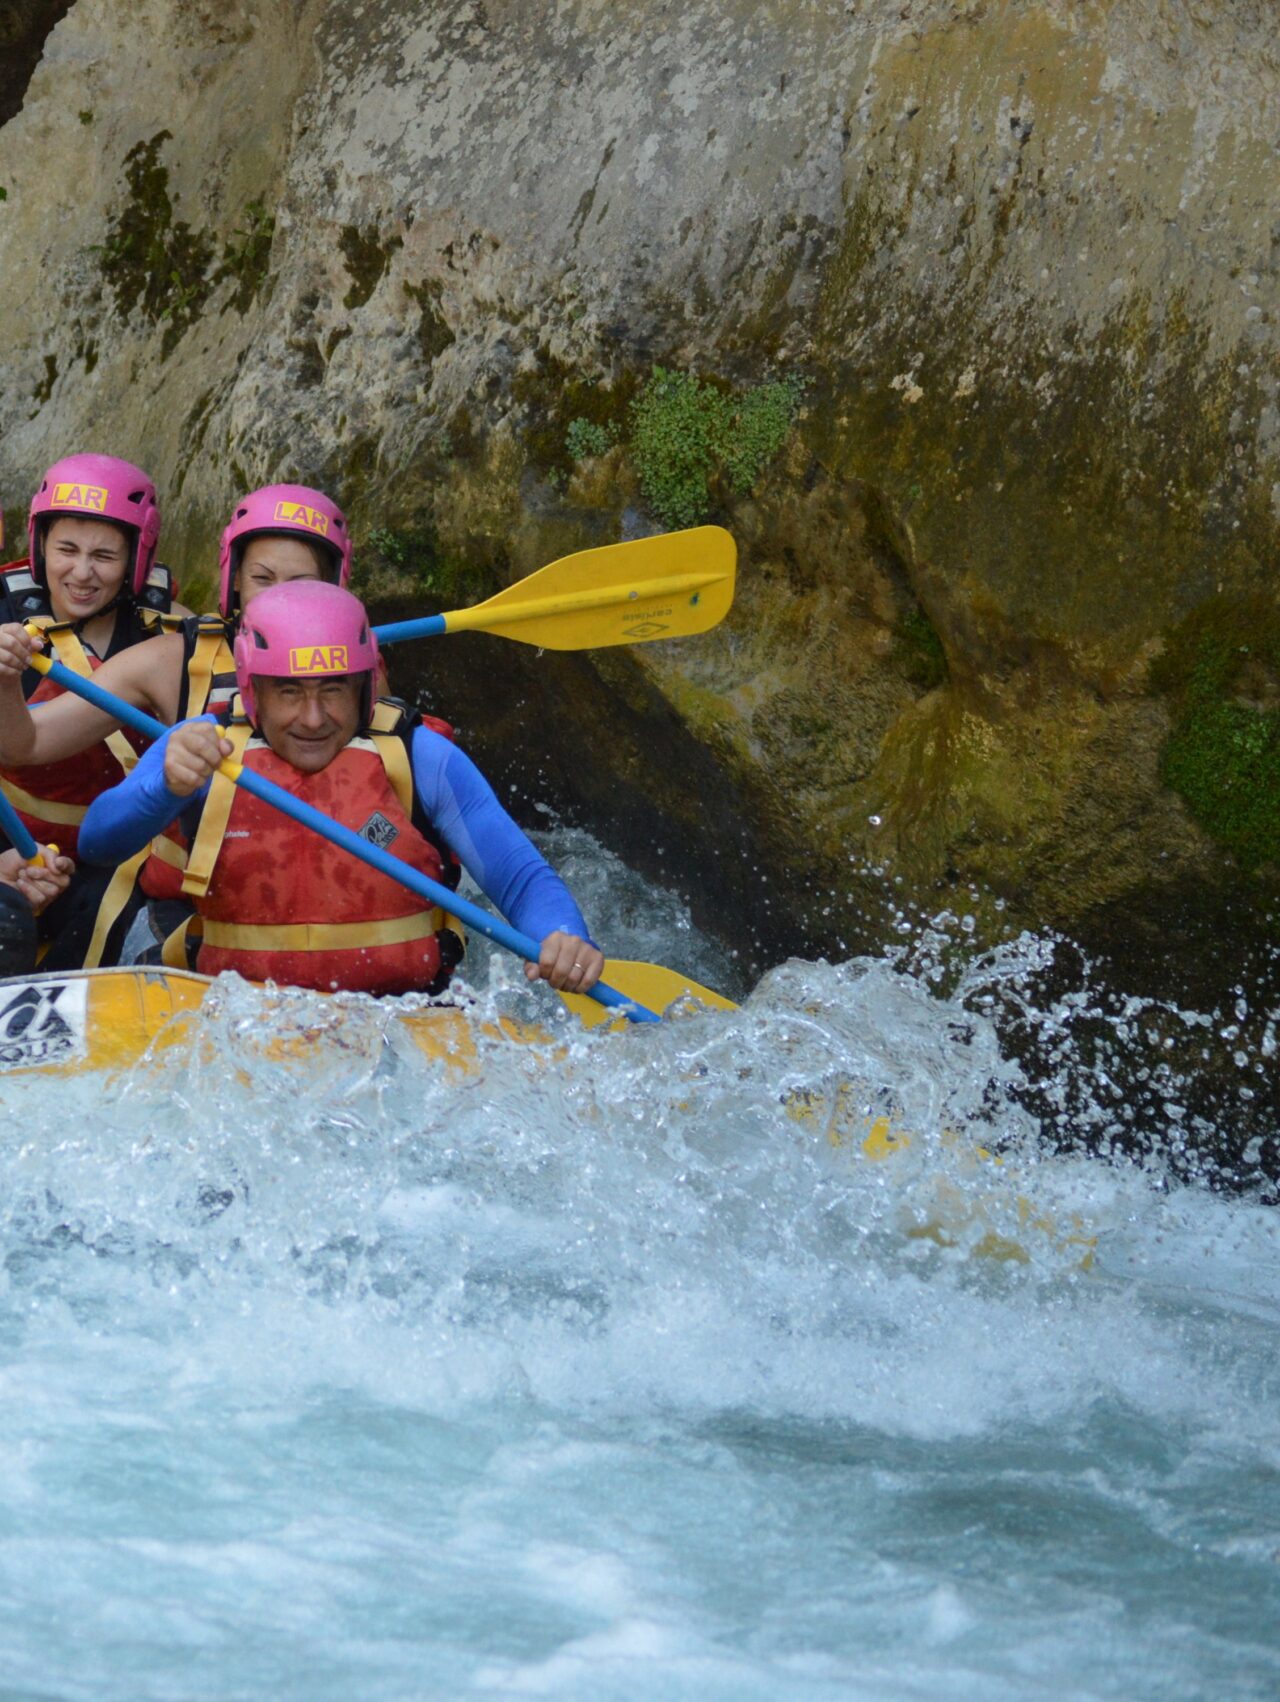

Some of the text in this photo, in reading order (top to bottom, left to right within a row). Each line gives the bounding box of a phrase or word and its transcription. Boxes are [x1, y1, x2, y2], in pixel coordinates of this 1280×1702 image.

[53, 486, 102, 509] LAR
[276, 503, 326, 533] LAR
[292, 648, 347, 671] LAR
